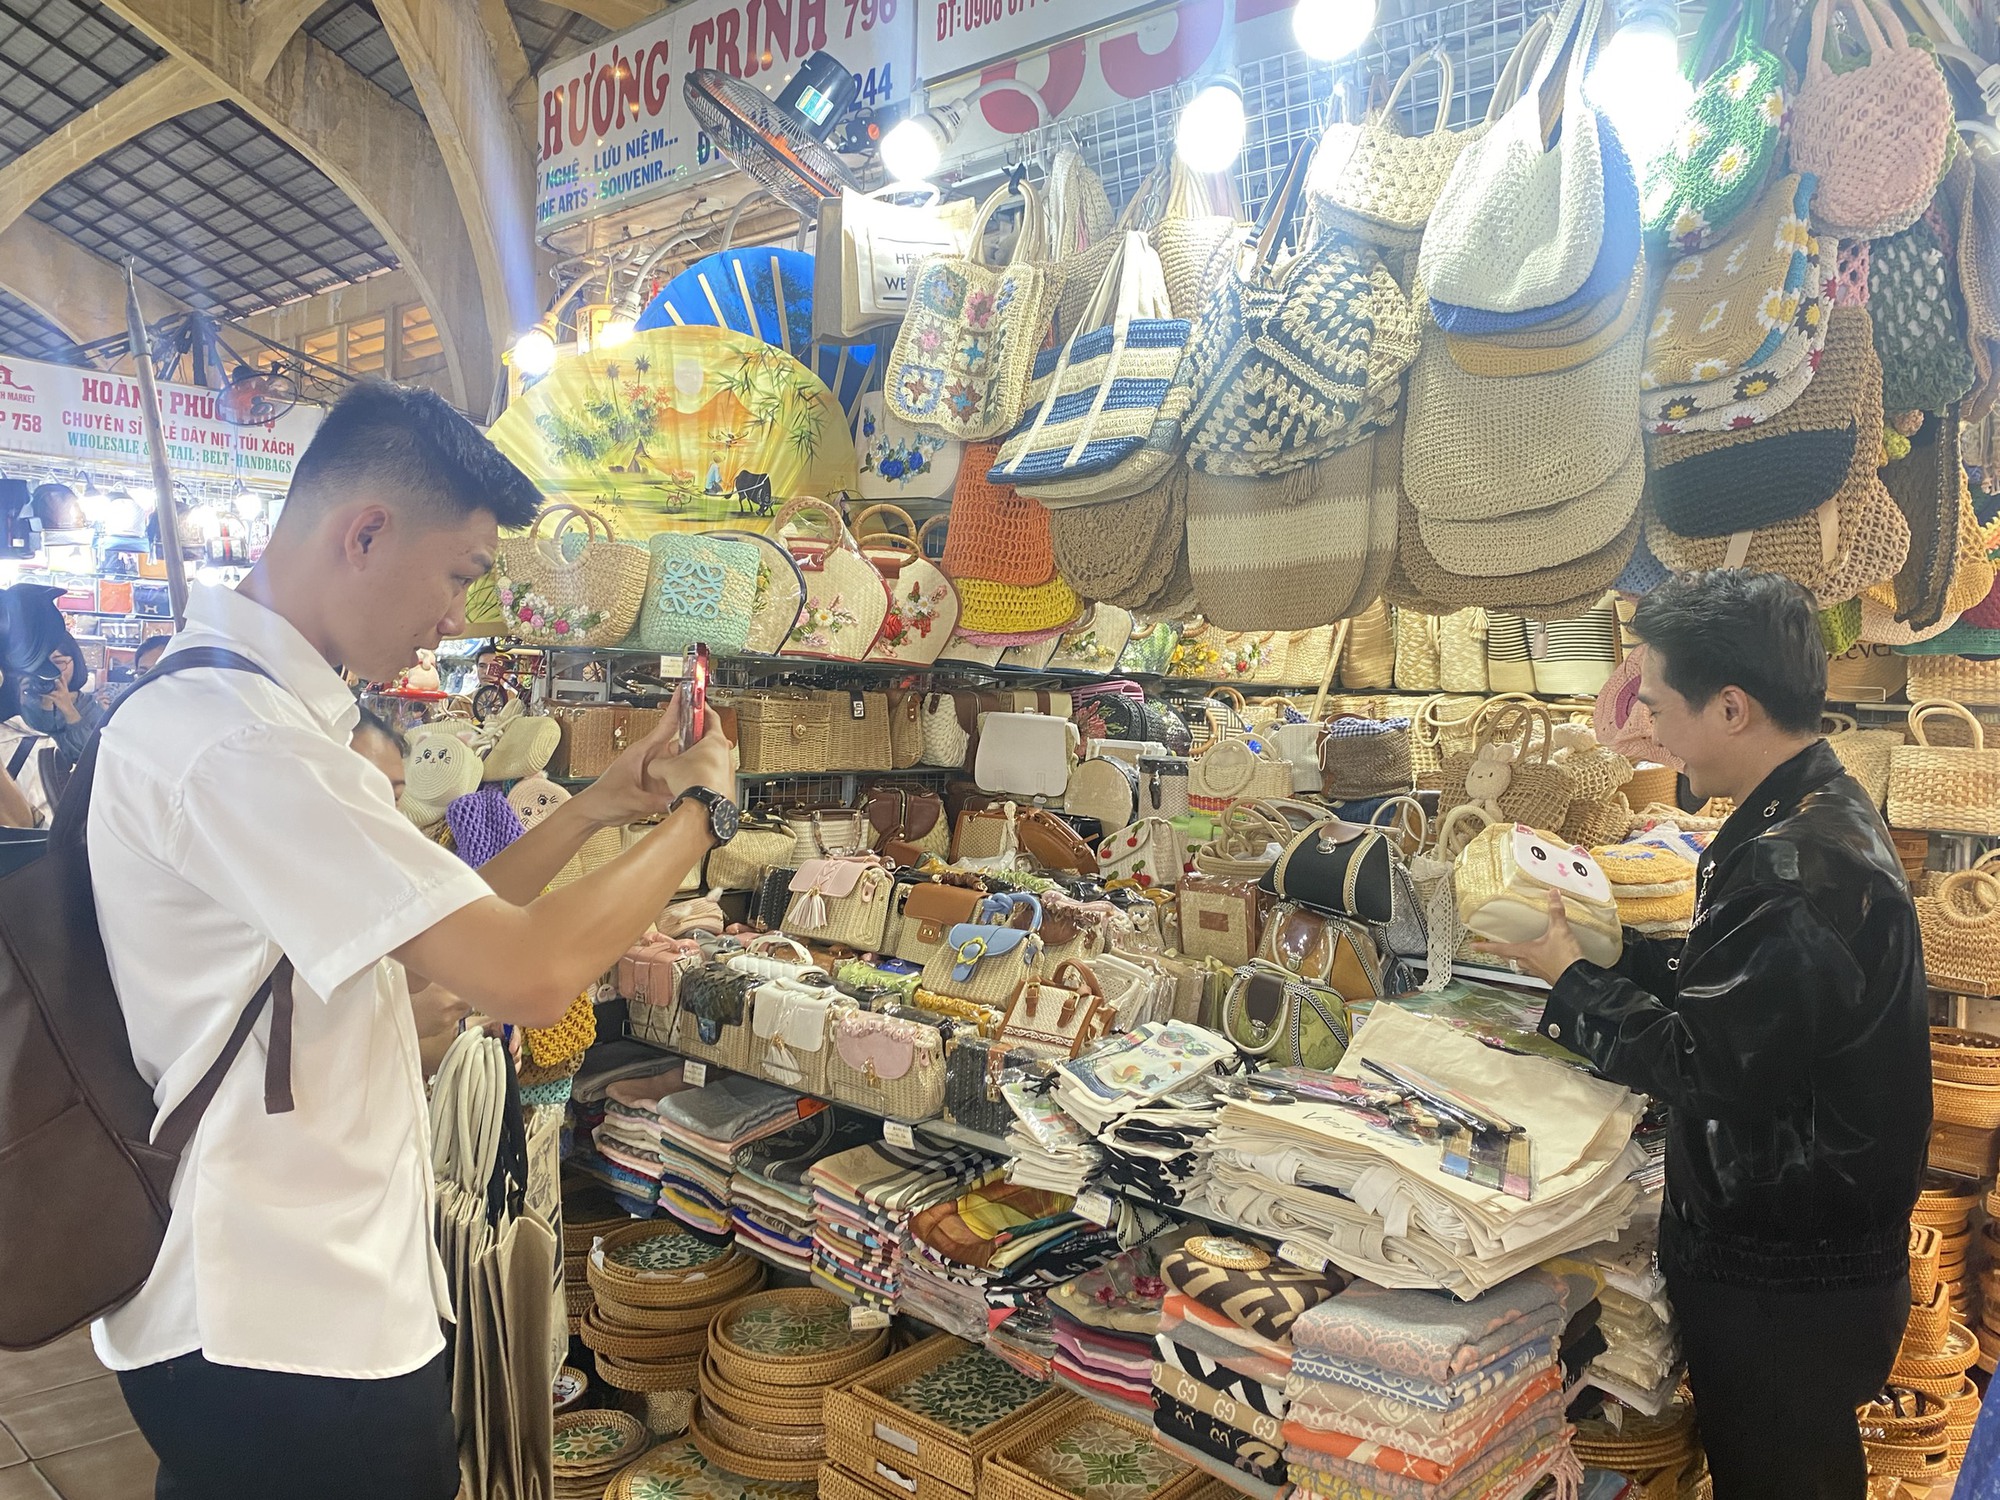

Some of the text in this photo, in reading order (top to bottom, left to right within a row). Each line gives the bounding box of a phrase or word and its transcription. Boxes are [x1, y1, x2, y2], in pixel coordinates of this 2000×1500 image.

[542, 40, 670, 161] HƯƠNG
[558, 187, 588, 214] ARTS
[7, 391, 36, 404] MARKET
[82, 377, 163, 412] HOÀN
[12, 412, 42, 434] 758
[62, 410, 124, 433] CHUYÊN
[181, 425, 206, 446] DÂY
[239, 433, 258, 451] TÚI
[262, 437, 295, 457] XÁCH
[67, 431, 140, 454] WHOLESALE
[202, 450, 230, 466] BELT
[235, 452, 292, 474] HANDBAGS
